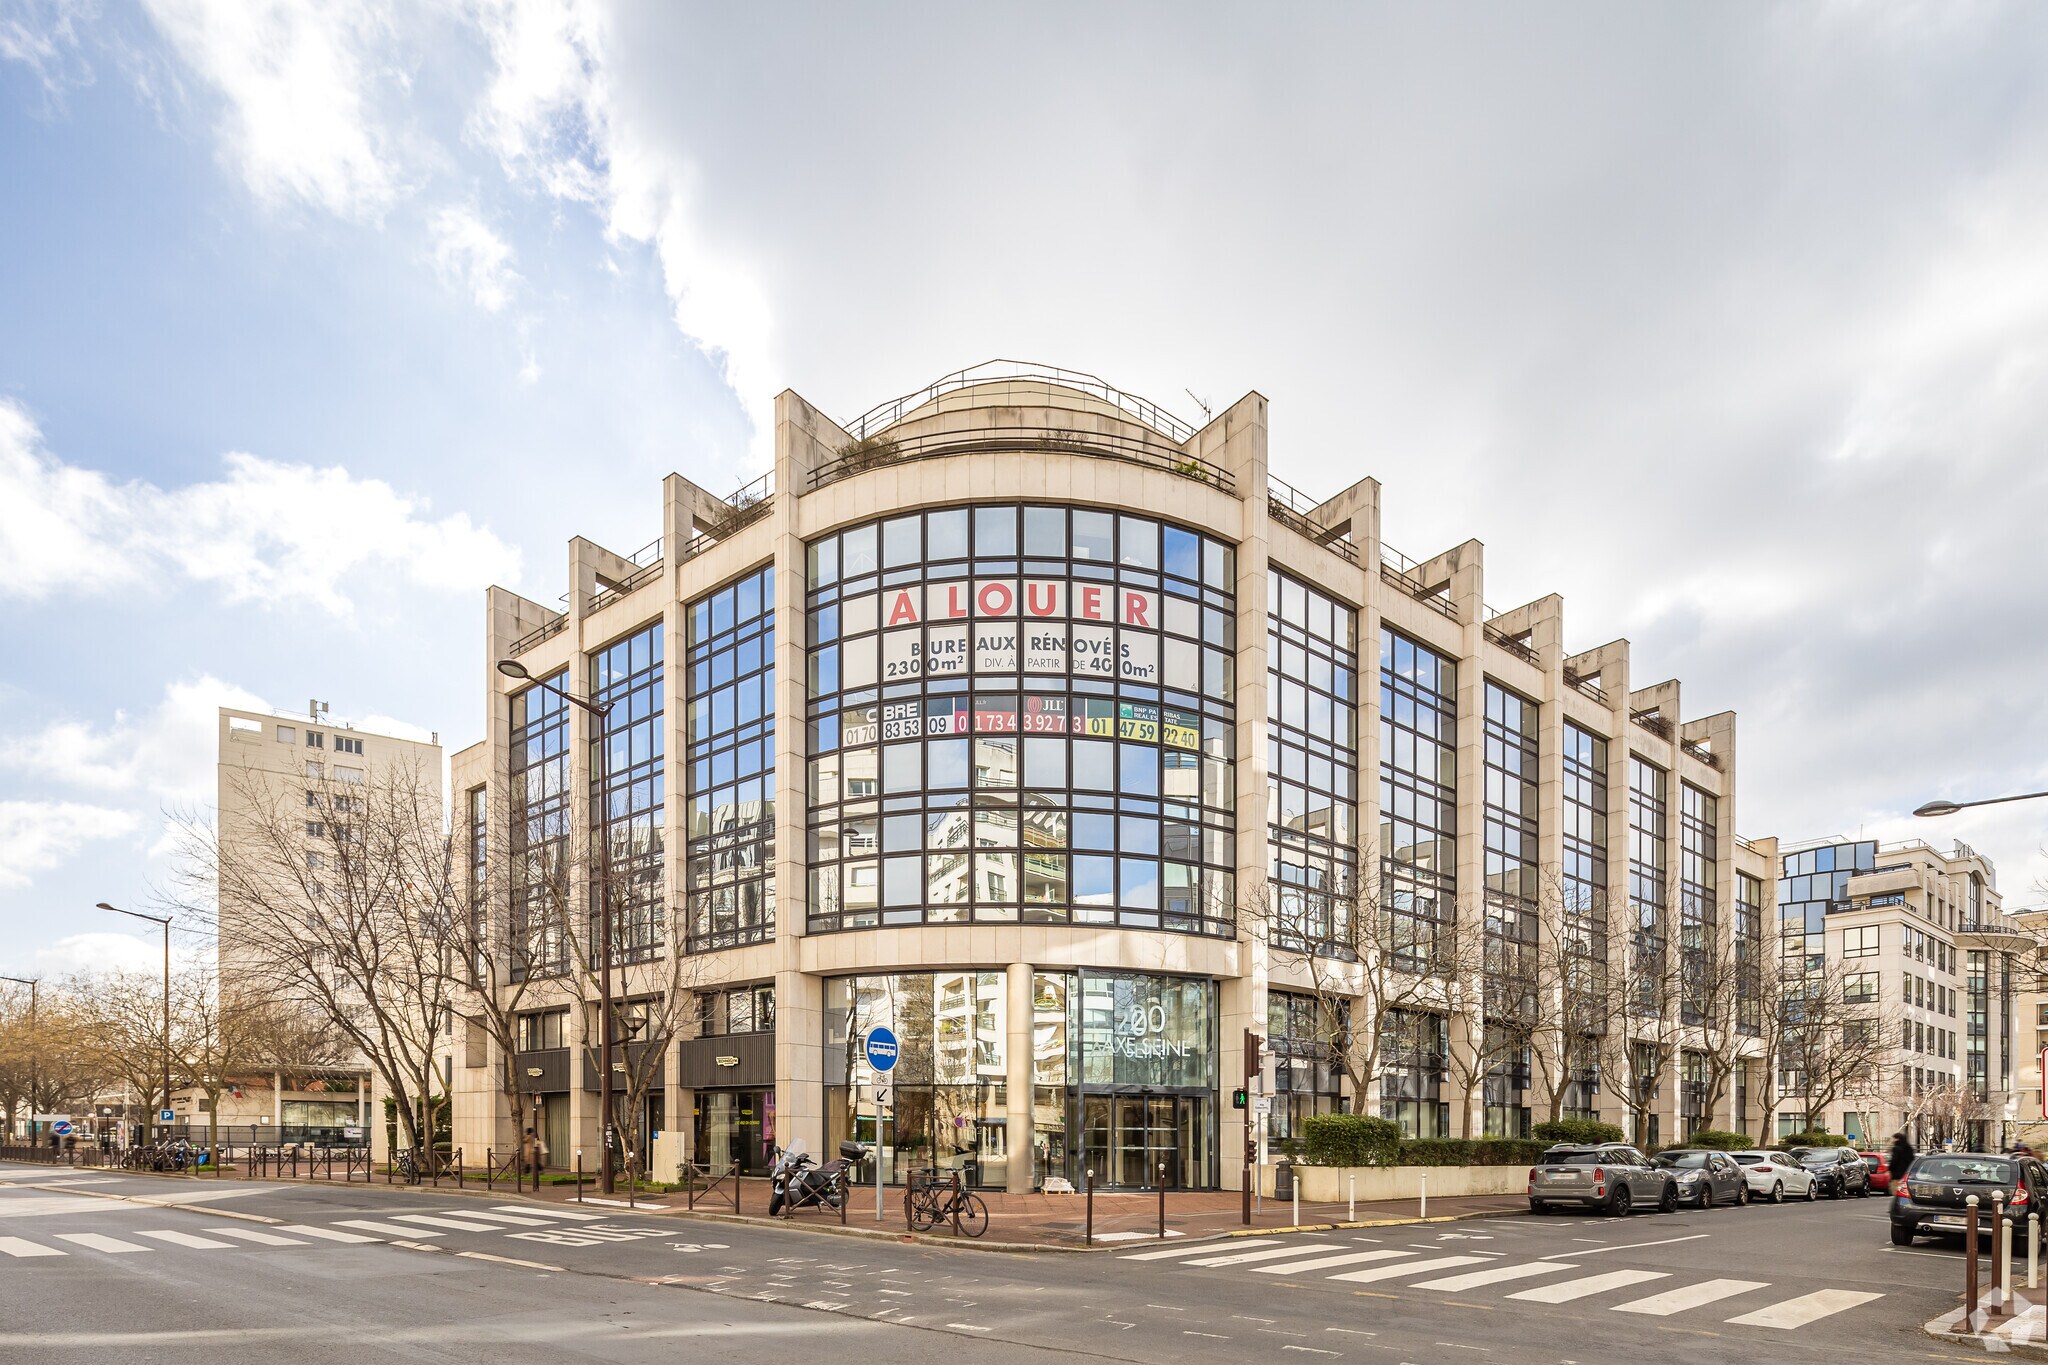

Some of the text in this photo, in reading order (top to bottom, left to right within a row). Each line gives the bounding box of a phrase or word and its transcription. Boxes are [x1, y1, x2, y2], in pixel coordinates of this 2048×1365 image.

[948, 583, 1150, 627] LOUER
[985, 658, 1004, 668] DIV.
[1027, 658, 1060, 669] PARTIR
[1042, 700, 1064, 711] JLL
[1134, 706, 1147, 714] BNP
[1134, 712, 1149, 720] REAL
[504, 1224, 684, 1247] BUS
